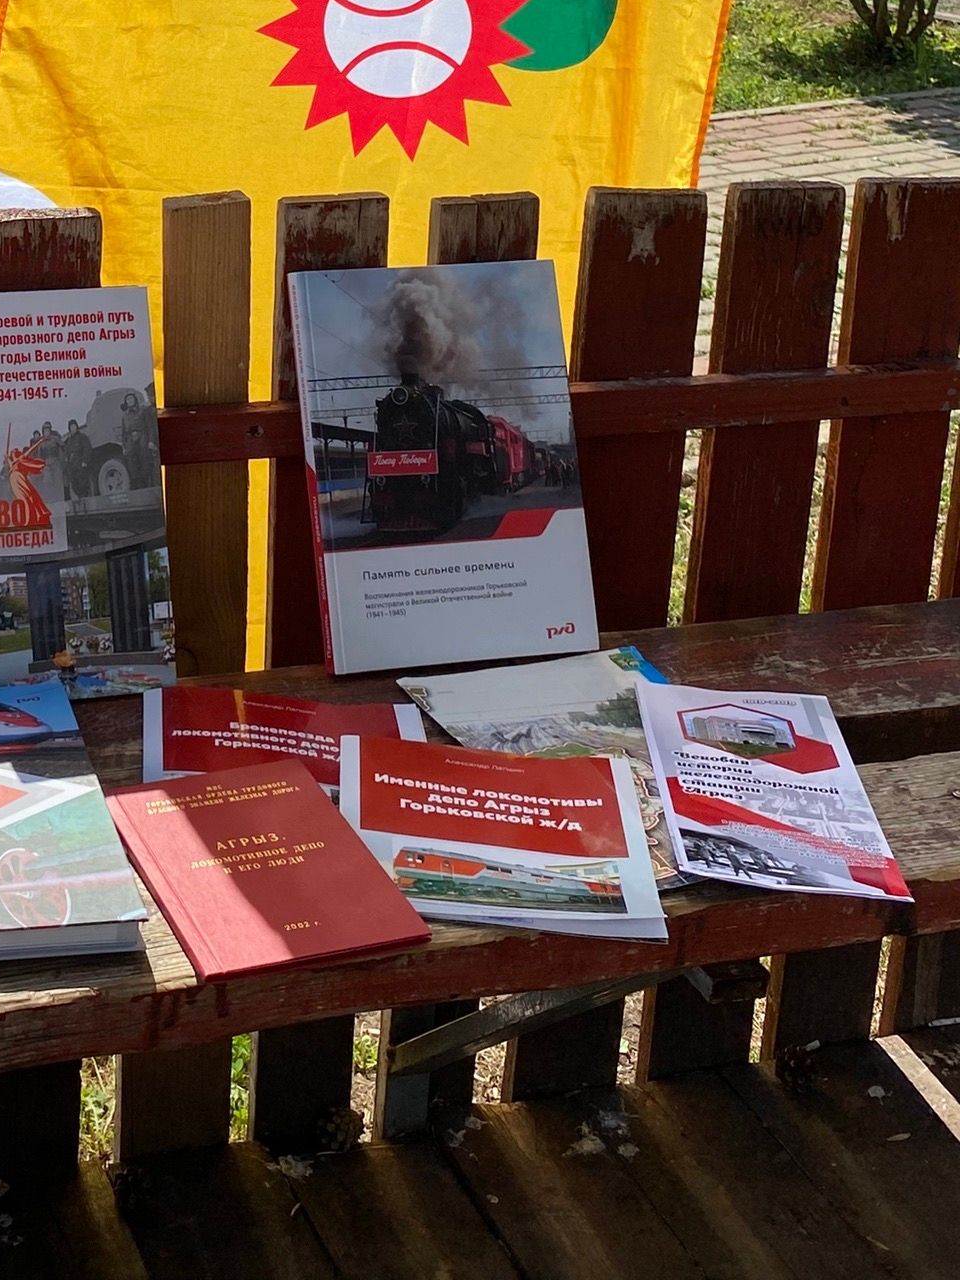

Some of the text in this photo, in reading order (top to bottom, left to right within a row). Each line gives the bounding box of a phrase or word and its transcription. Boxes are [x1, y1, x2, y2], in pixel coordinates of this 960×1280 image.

[36, 316, 44, 327] и
[47, 311, 104, 328] трудовой
[107, 310, 135, 324] путь
[67, 329, 96, 344] депо
[99, 327, 136, 343] Агрыз
[0, 352, 31, 366] годы
[35, 347, 87, 363] Великой
[84, 365, 122, 378] войны
[52, 387, 68, 399] гг.
[362, 560, 515, 581] Память сильнее времени
[411, 595, 440, 606] Великой
[440, 591, 491, 603] Отечественной
[171, 729, 340, 753] локомотивного депо
[229, 721, 336, 745] Бронепоезда
[214, 738, 318, 759] Горьковской
[374, 772, 604, 808] Именные локомотивы
[679, 770, 841, 796] железнодорожной
[427, 793, 551, 817] депо Агрыз
[399, 798, 583, 833] Горьковской ж/д
[216, 832, 286, 851] АГРЫЗ.
[191, 840, 326, 869] ЛОКОМОТИВНОЕ ДЕПО
[238, 861, 262, 872] ЕГО
[267, 854, 305, 869] ЛЮДИ
[284, 920, 311, 932] 2002
